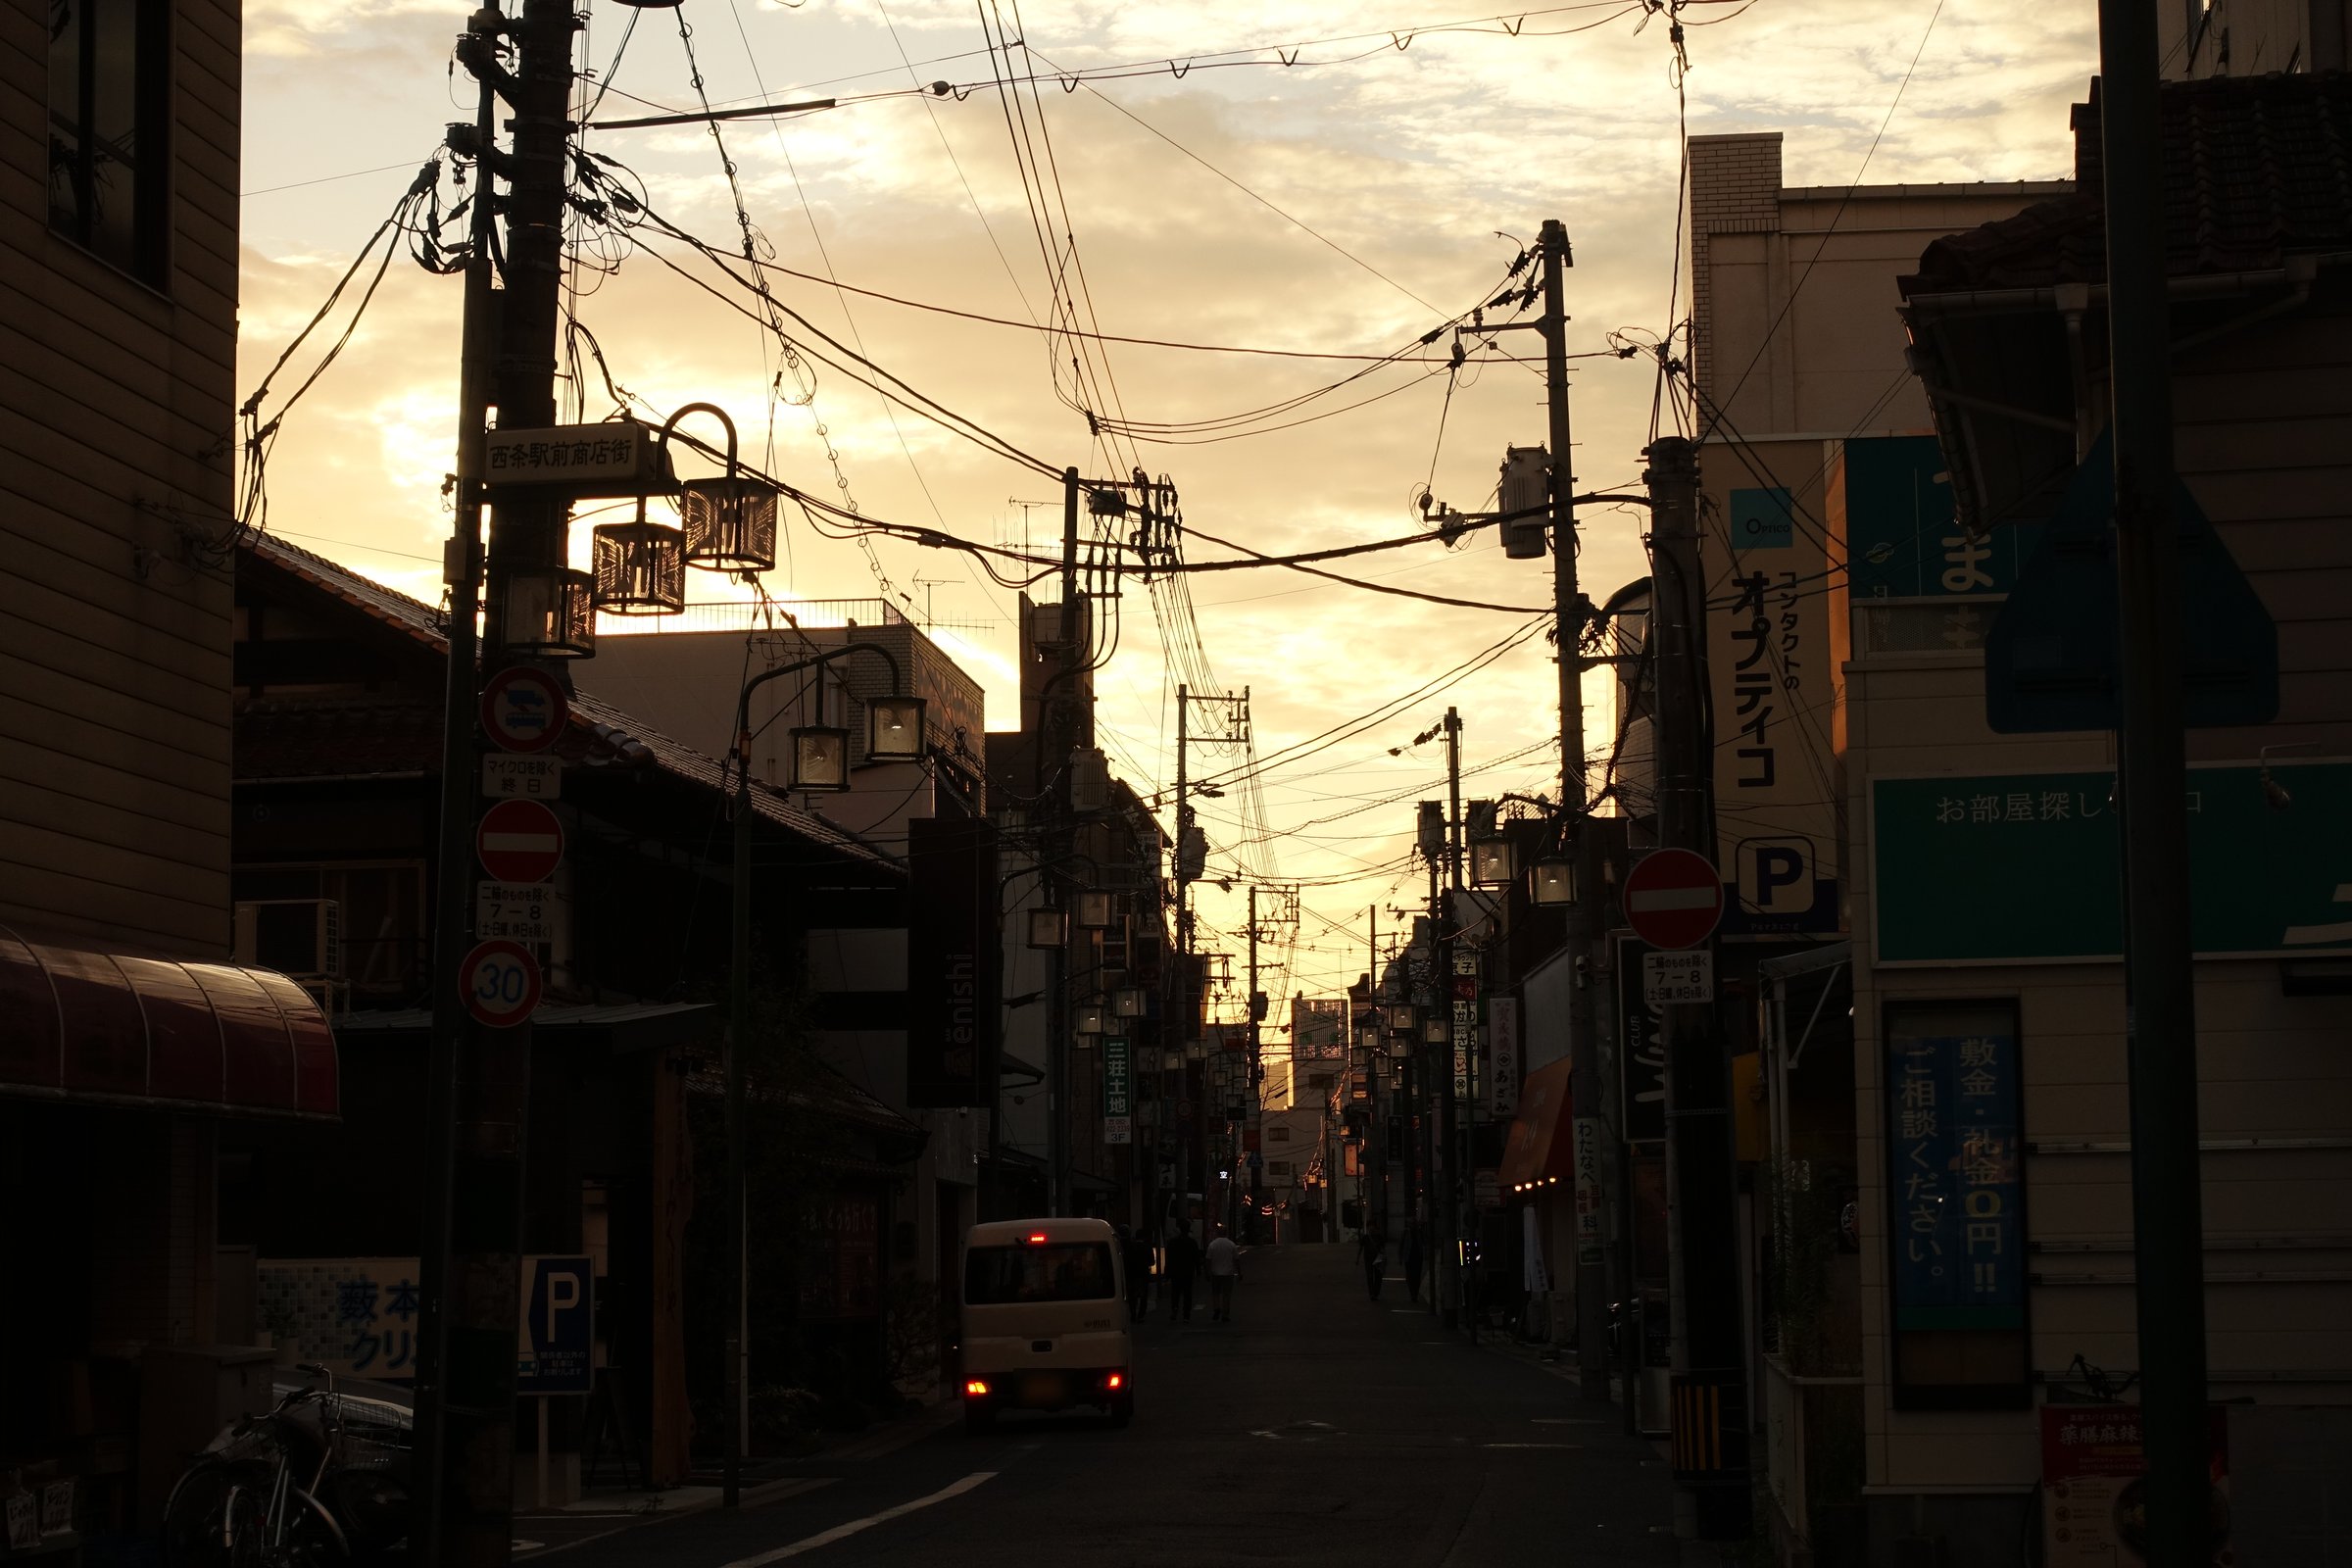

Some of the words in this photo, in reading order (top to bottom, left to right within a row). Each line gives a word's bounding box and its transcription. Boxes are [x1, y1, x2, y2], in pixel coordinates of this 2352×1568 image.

[489, 438, 632, 470] 西条駅前商店街
[1779, 571, 1800, 690] コンタクトの
[1731, 570, 1775, 788] オプティコ
[488, 760, 555, 775] マイクロを除く
[482, 886, 549, 902] 二輪のものを除く
[1756, 847, 1804, 906] P
[477, 963, 523, 1004] 30
[1647, 955, 1707, 969] 二輪のものを除く
[945, 954, 973, 1044] enishi
[1107, 1042, 1127, 1114] 三荘土地
[1111, 1133, 1126, 1143] 3F
[1900, 1046, 1944, 1278] ご相談ください。
[548, 1272, 580, 1343] P
[350, 1330, 418, 1372] クリ
